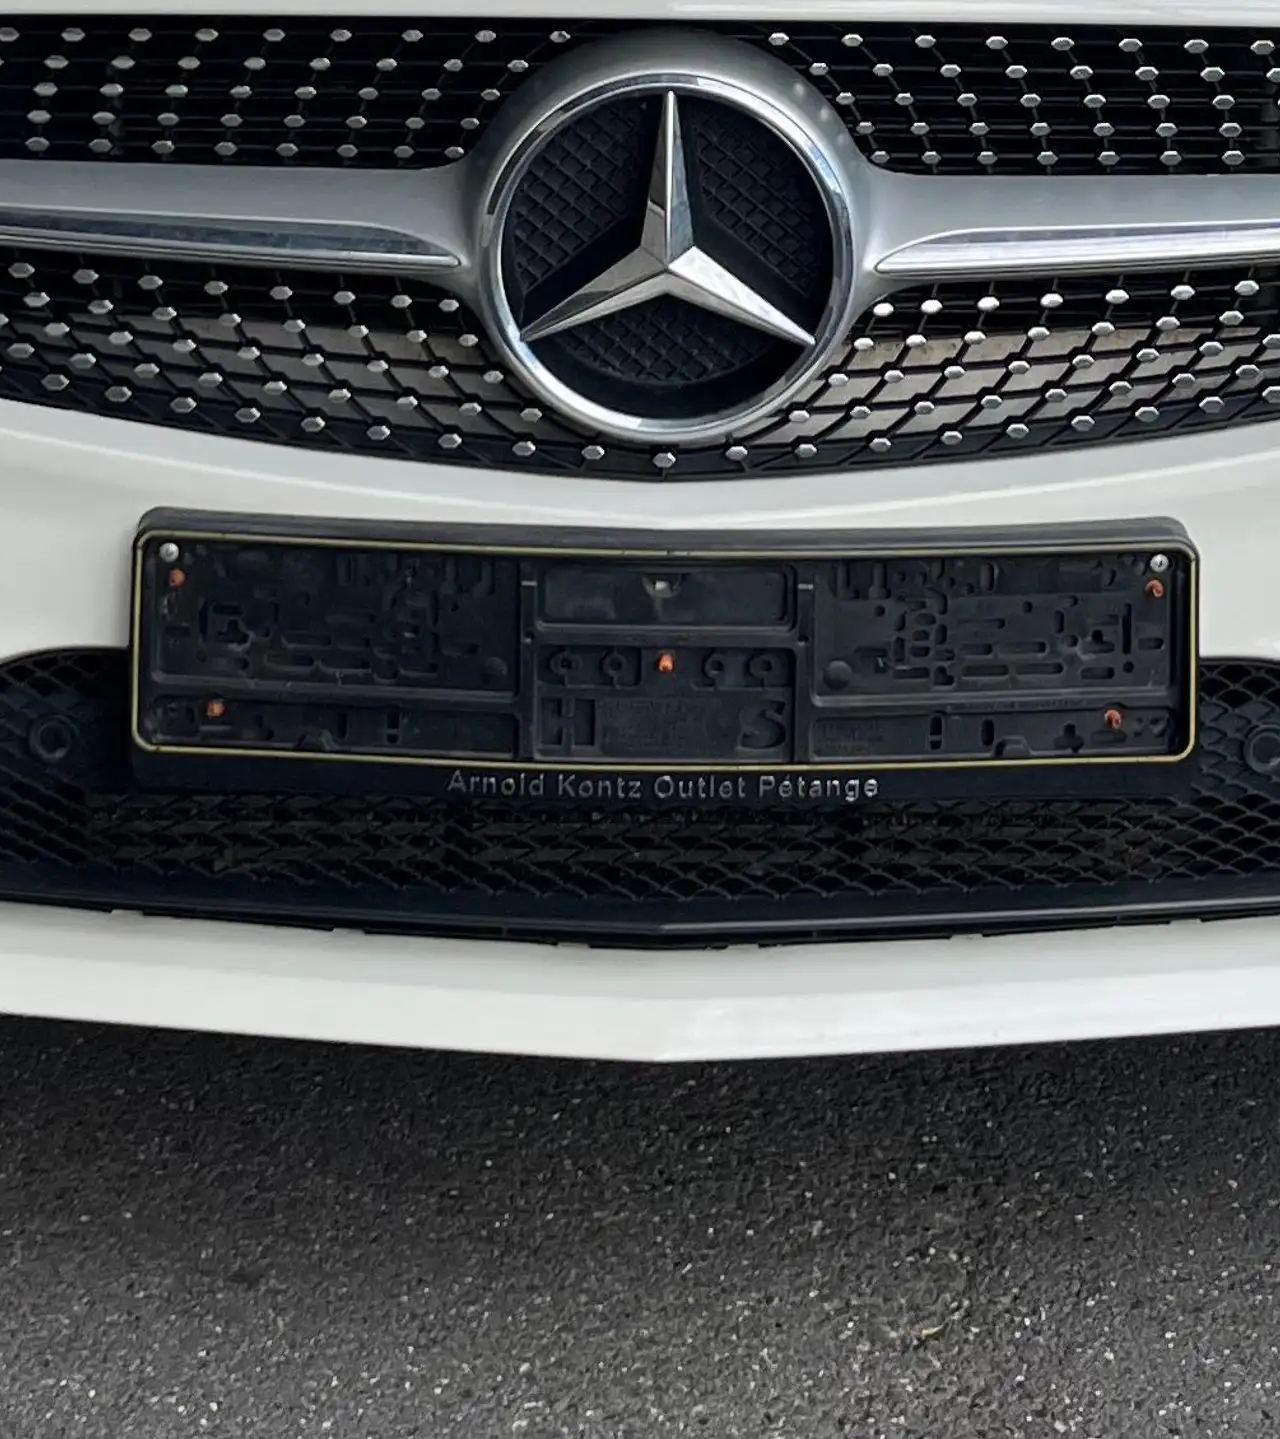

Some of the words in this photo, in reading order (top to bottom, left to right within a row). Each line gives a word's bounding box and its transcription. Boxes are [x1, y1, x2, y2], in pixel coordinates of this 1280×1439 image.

[446, 768, 545, 797] Arnold
[557, 773, 642, 799] Kontz
[654, 774, 746, 799] Outlet
[758, 773, 880, 802] Pétange
